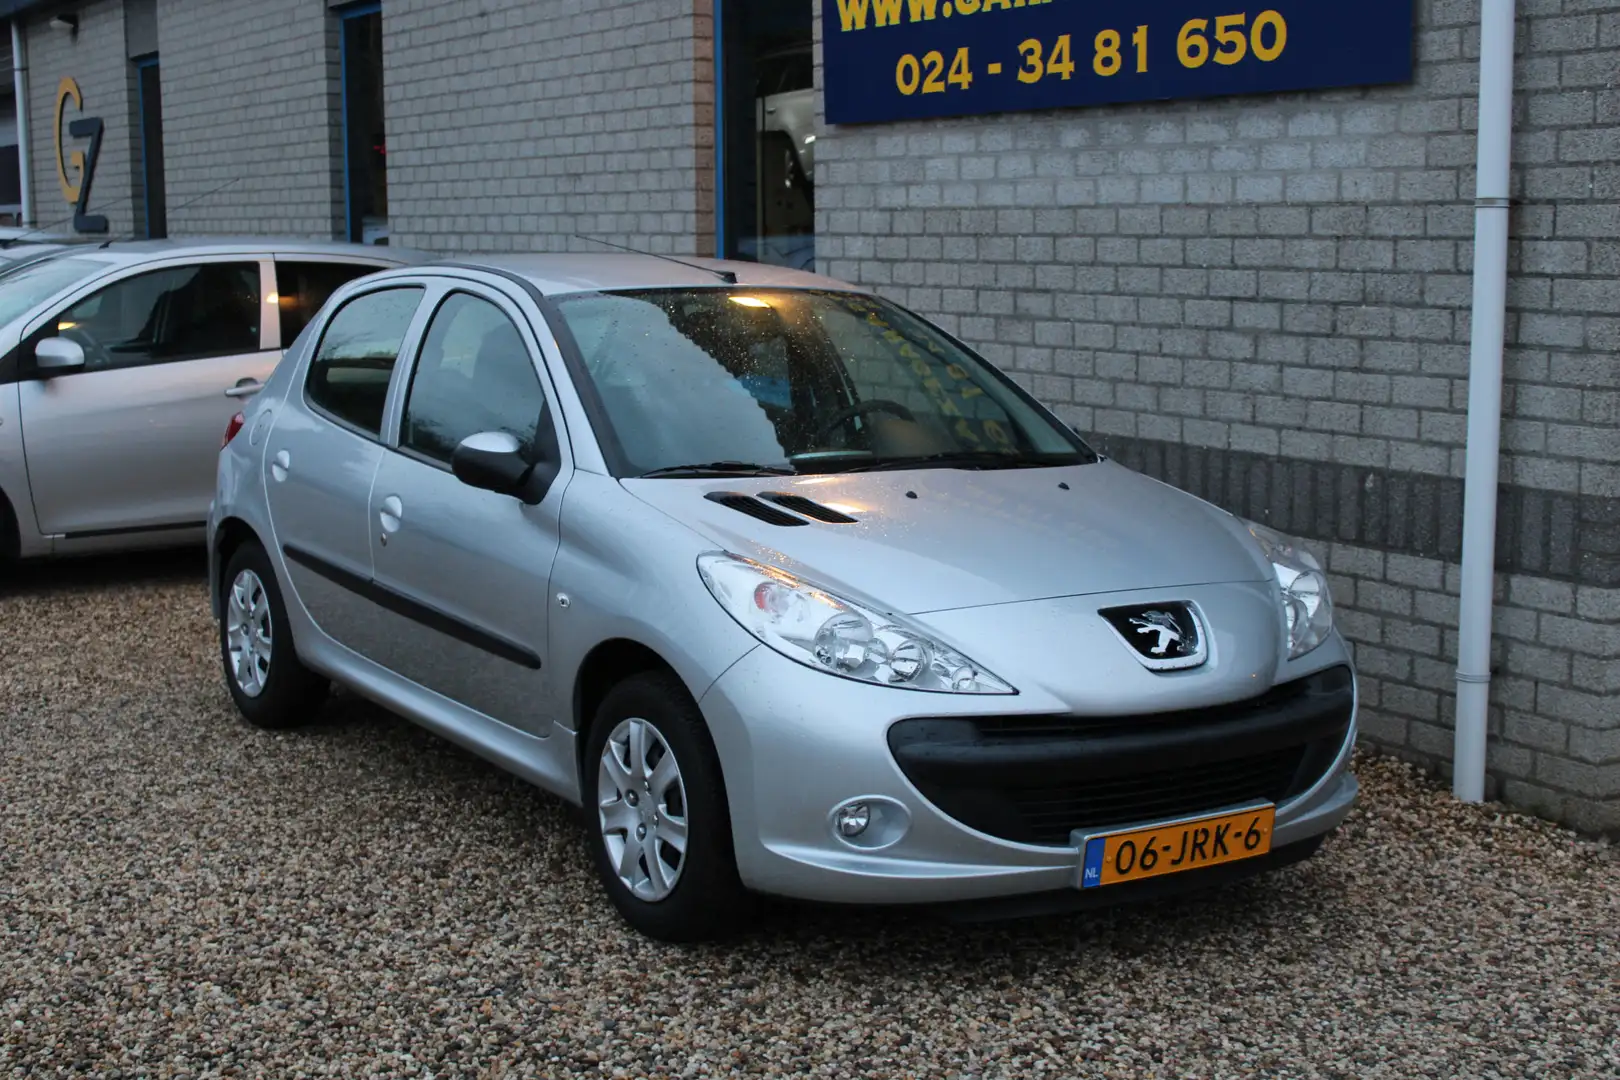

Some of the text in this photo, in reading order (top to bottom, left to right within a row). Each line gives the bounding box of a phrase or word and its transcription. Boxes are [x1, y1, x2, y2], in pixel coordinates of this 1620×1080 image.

[895, 47, 973, 95] 024
[1017, 33, 1075, 84] 34
[1093, 24, 1148, 77] 81
[1176, 9, 1287, 69] 650
[1085, 867, 1099, 879] NL
[1115, 817, 1261, 875] 06-JRK-6
